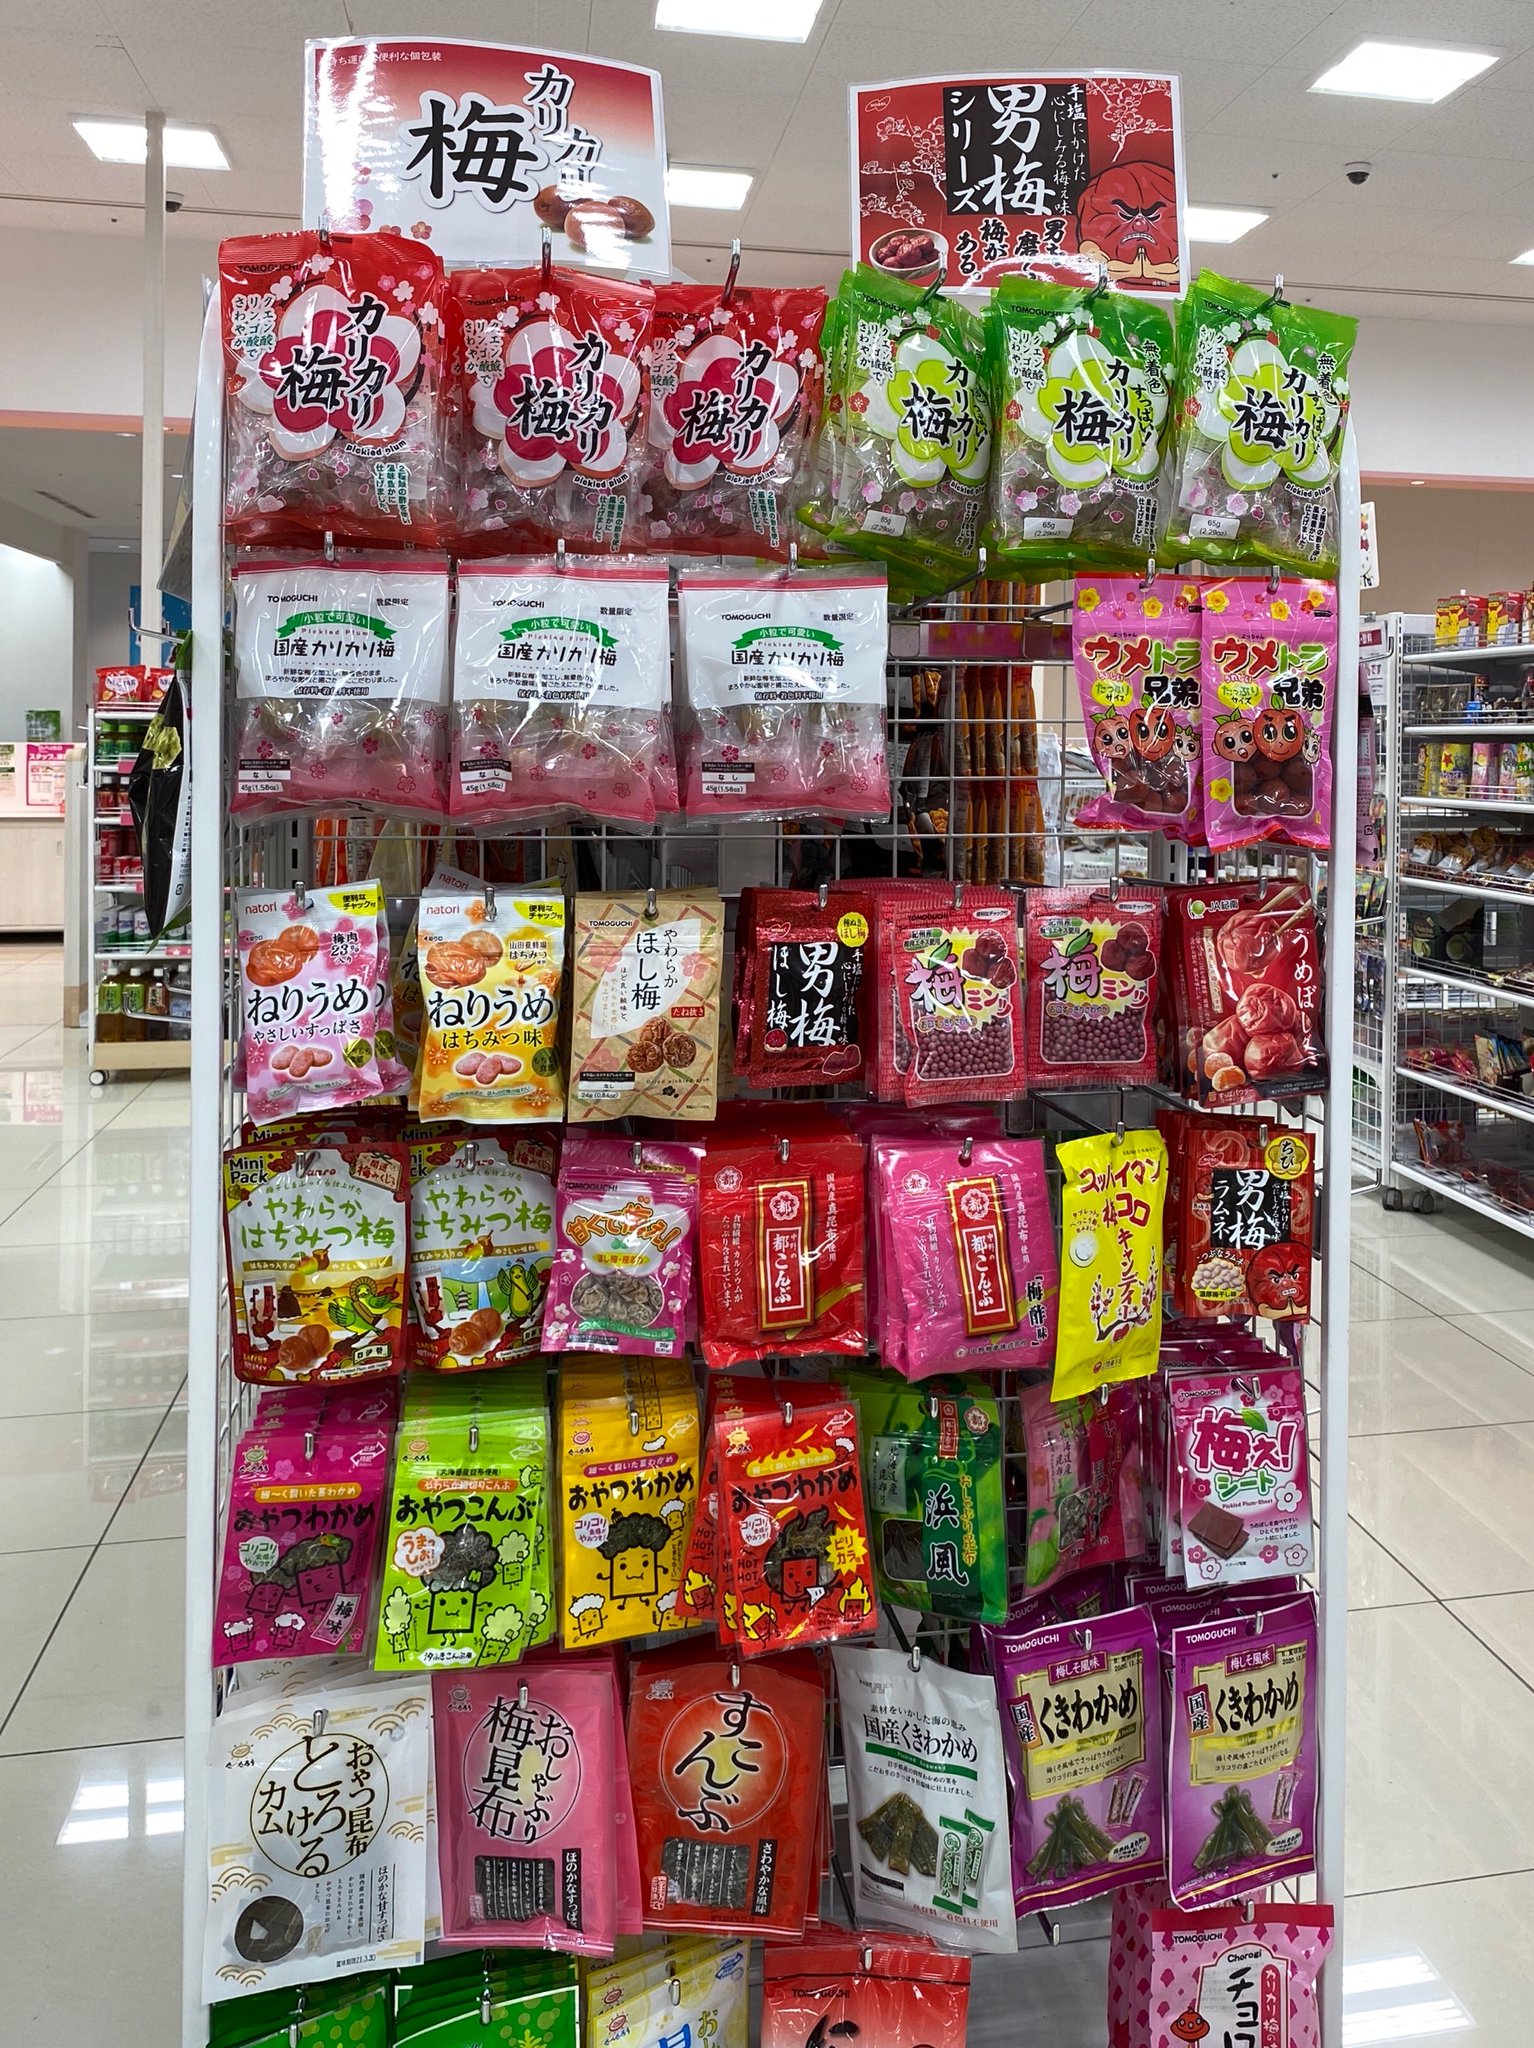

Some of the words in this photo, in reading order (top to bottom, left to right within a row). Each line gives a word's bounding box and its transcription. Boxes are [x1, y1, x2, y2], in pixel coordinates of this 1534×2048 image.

[978, 84, 1055, 215] 男梅
[1066, 84, 1086, 181] 手塩にかけた
[406, 99, 538, 202] 梅
[951, 91, 982, 213] シリーズ
[981, 220, 1008, 260] 梅が
[233, 297, 246, 347] さわやか
[246, 296, 259, 359] リンゴ酸で
[341, 295, 388, 429] カリカリ
[465, 321, 478, 371] さわやか
[859, 323, 871, 368] さわやか
[1022, 332, 1034, 391] リンゴ酸で
[278, 346, 351, 410] 梅
[651, 339, 665, 397] リンゴ酸で
[1143, 341, 1164, 394] 無着色
[510, 376, 581, 440] 梅
[573, 333, 613, 463] カリカリ
[732, 342, 772, 460] カリカリ
[901, 382, 958, 446] 梅
[946, 359, 974, 461] カリカリ
[1106, 358, 1136, 459] カリカリ
[1282, 368, 1313, 463] カリカリ
[677, 390, 734, 445] 梅
[1054, 388, 1117, 445] 梅
[1233, 386, 1293, 448] 梅
[609, 473, 628, 487] plum
[1314, 486, 1331, 498] plum
[1043, 521, 1055, 529] 65g
[1208, 519, 1221, 527] 65g
[304, 612, 365, 625] 小粒で可愛い
[600, 607, 633, 616] 数量限定
[274, 638, 395, 658] 国産カリカリ梅
[759, 628, 815, 639] 小粒で可愛い
[1084, 637, 1201, 674] ウメトラ
[1214, 638, 1329, 674] ウメトラ
[1144, 676, 1201, 708] 兄弟
[1222, 684, 1260, 698] たっぷり
[1231, 696, 1252, 705] サイズ
[1273, 677, 1325, 710] 兄弟
[342, 894, 366, 902] 便利な
[438, 873, 469, 891] natori
[245, 902, 277, 914] natori
[426, 905, 460, 916] natori
[529, 912, 563, 920] チャック付
[331, 944, 359, 957] 23%
[332, 933, 358, 944] 梅肉
[840, 929, 866, 939] ほし梅
[509, 950, 547, 960] はちみつ
[631, 932, 661, 1010] ほし梅
[663, 928, 678, 988] やわらか
[1040, 943, 1101, 1000] 梅
[767, 945, 792, 1030] ほし梅
[905, 939, 964, 1014] 梅
[1102, 979, 1149, 1008] ミンツ
[247, 978, 369, 1026] ねりうめ
[429, 989, 554, 1028] ねりうめ
[789, 942, 841, 1047] 男梅
[967, 988, 1014, 1018] ミンツ
[253, 1019, 361, 1044] やさしいすっぱさ
[442, 1030, 543, 1049] はちみつ味
[229, 1157, 264, 1171] Mini
[1280, 1142, 1295, 1168] ちび
[230, 1170, 269, 1184] Pack
[1079, 1158, 1161, 1194] スッパイマン
[263, 1195, 362, 1220] やわらか
[426, 1184, 523, 1210] やわらか
[777, 1200, 792, 1214] 都
[969, 1198, 982, 1213] 都
[1102, 1197, 1118, 1229] 梅
[1116, 1192, 1151, 1228] コロ
[1213, 1180, 1230, 1240] ラムネ
[1229, 1169, 1270, 1250] 男梅
[241, 1215, 396, 1250] はちみつ梅
[773, 1233, 792, 1303] 都こんぶ
[971, 1234, 994, 1307] 都こんぶ
[1117, 1227, 1137, 1320] キャンディー
[1180, 1389, 1221, 1398] TOMOGUCHI
[1190, 1407, 1298, 1474] 梅ぇ!
[568, 1467, 694, 1511] おやつわかめ
[732, 1466, 857, 1513] おやつわかめ
[1215, 1472, 1276, 1500] シート
[234, 1502, 376, 1533] おやつわかめ
[395, 1495, 537, 1525] おやつこんぶ
[574, 1518, 607, 1530] コリコリ
[740, 1518, 769, 1531] コリコリ
[960, 1474, 978, 1568] おしゃぶり昆布
[692, 1539, 714, 1550] HOT
[695, 1527, 717, 1540] HOT
[835, 1536, 854, 1550] ピリ
[926, 1483, 969, 1586] 浜風
[1259, 1524, 1298, 1534] ひとくちサイズの
[240, 1541, 279, 1555] コリコリ
[738, 1559, 758, 1569] HOT
[837, 1552, 856, 1566] カラ
[738, 1570, 758, 1582] HOT
[326, 1600, 354, 1634] 梅味
[1161, 1599, 1212, 1613] TOMOGUCHI
[1005, 1633, 1060, 1653] TOMOGUCHI
[1185, 1626, 1237, 1644] TOMOGUCHI
[1055, 1656, 1101, 1679] 梅しそ風味
[1230, 1651, 1271, 1672] 梅しそ風味
[1039, 1678, 1138, 1744] くきわかめ
[1187, 1693, 1211, 1732] 国産
[1215, 1671, 1300, 1735] くきわかめ
[863, 1713, 977, 1762] 国産くきわかめ
[1010, 1702, 1036, 1744] 国産
[468, 1696, 539, 1837] 梅昆布
[524, 1713, 573, 1844] おしゃぶり
[346, 1742, 375, 1857] おやつ昆布
[755, 1843, 773, 1913] さわやかな風味
[1173, 1933, 1222, 1944] TOMOGUCHI
[1227, 1949, 1262, 1963] Chorogi
